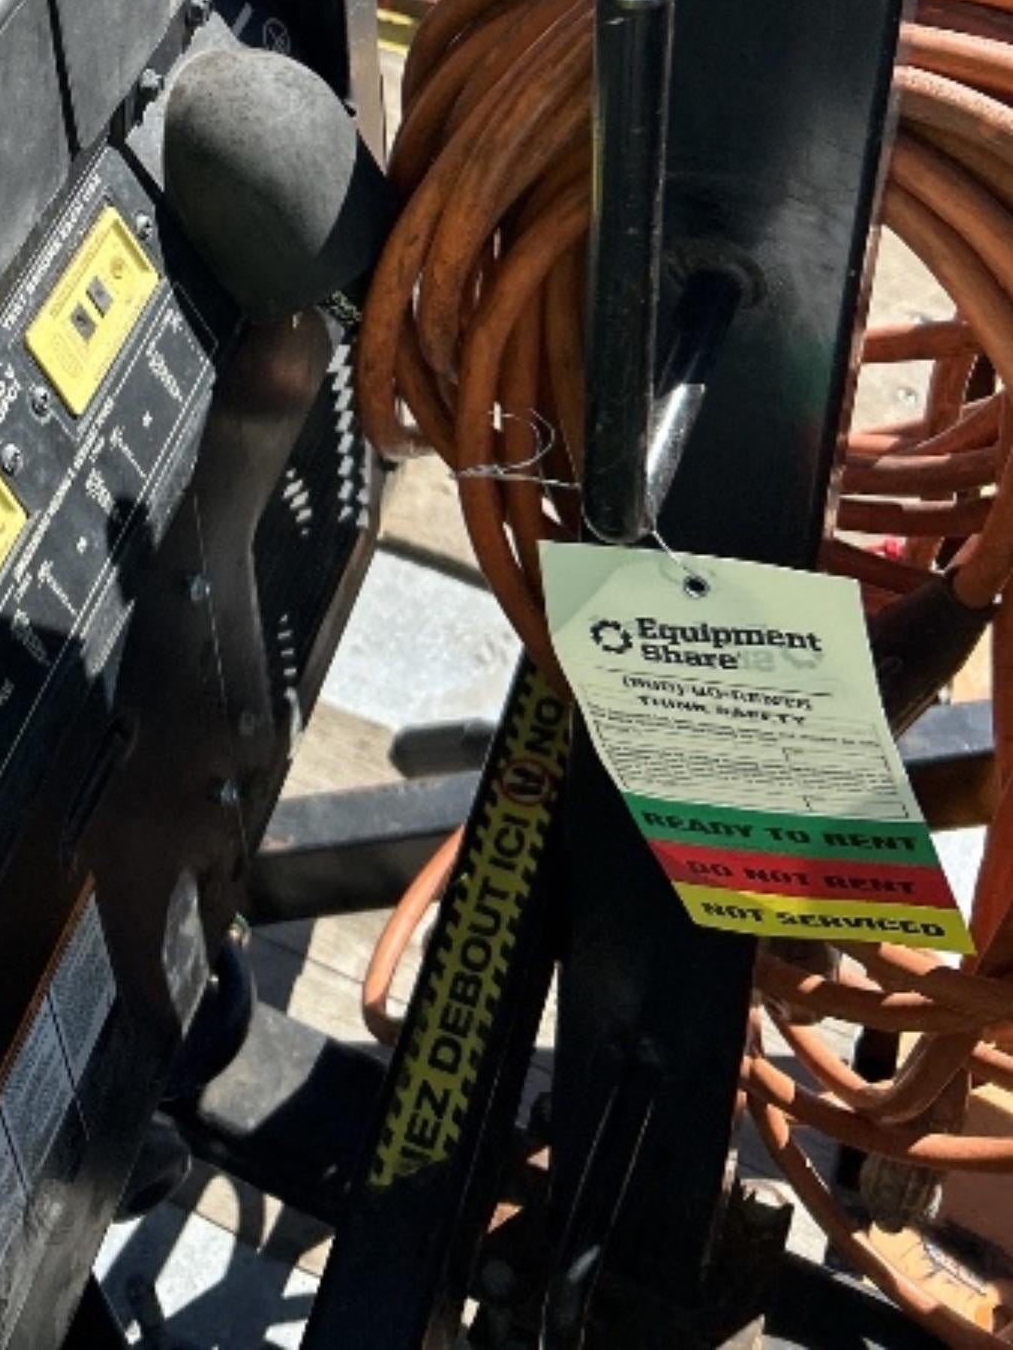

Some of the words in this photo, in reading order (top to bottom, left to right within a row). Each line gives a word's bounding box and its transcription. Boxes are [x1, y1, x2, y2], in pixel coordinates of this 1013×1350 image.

[636, 617, 822, 652] Equipment
[641, 644, 738, 670] Share
[643, 810, 757, 840] READY
[764, 824, 808, 845] TO
[823, 832, 918, 852] RENT
[686, 858, 734, 879] DO
[743, 866, 810, 889] NOT
[824, 874, 917, 896] RENT
[700, 900, 766, 922] NOT
[775, 911, 945, 939] SERVICED
[400, 1079, 452, 1165] EZ
[429, 887, 509, 1077] DEBOUT
[493, 813, 533, 873] ICI
